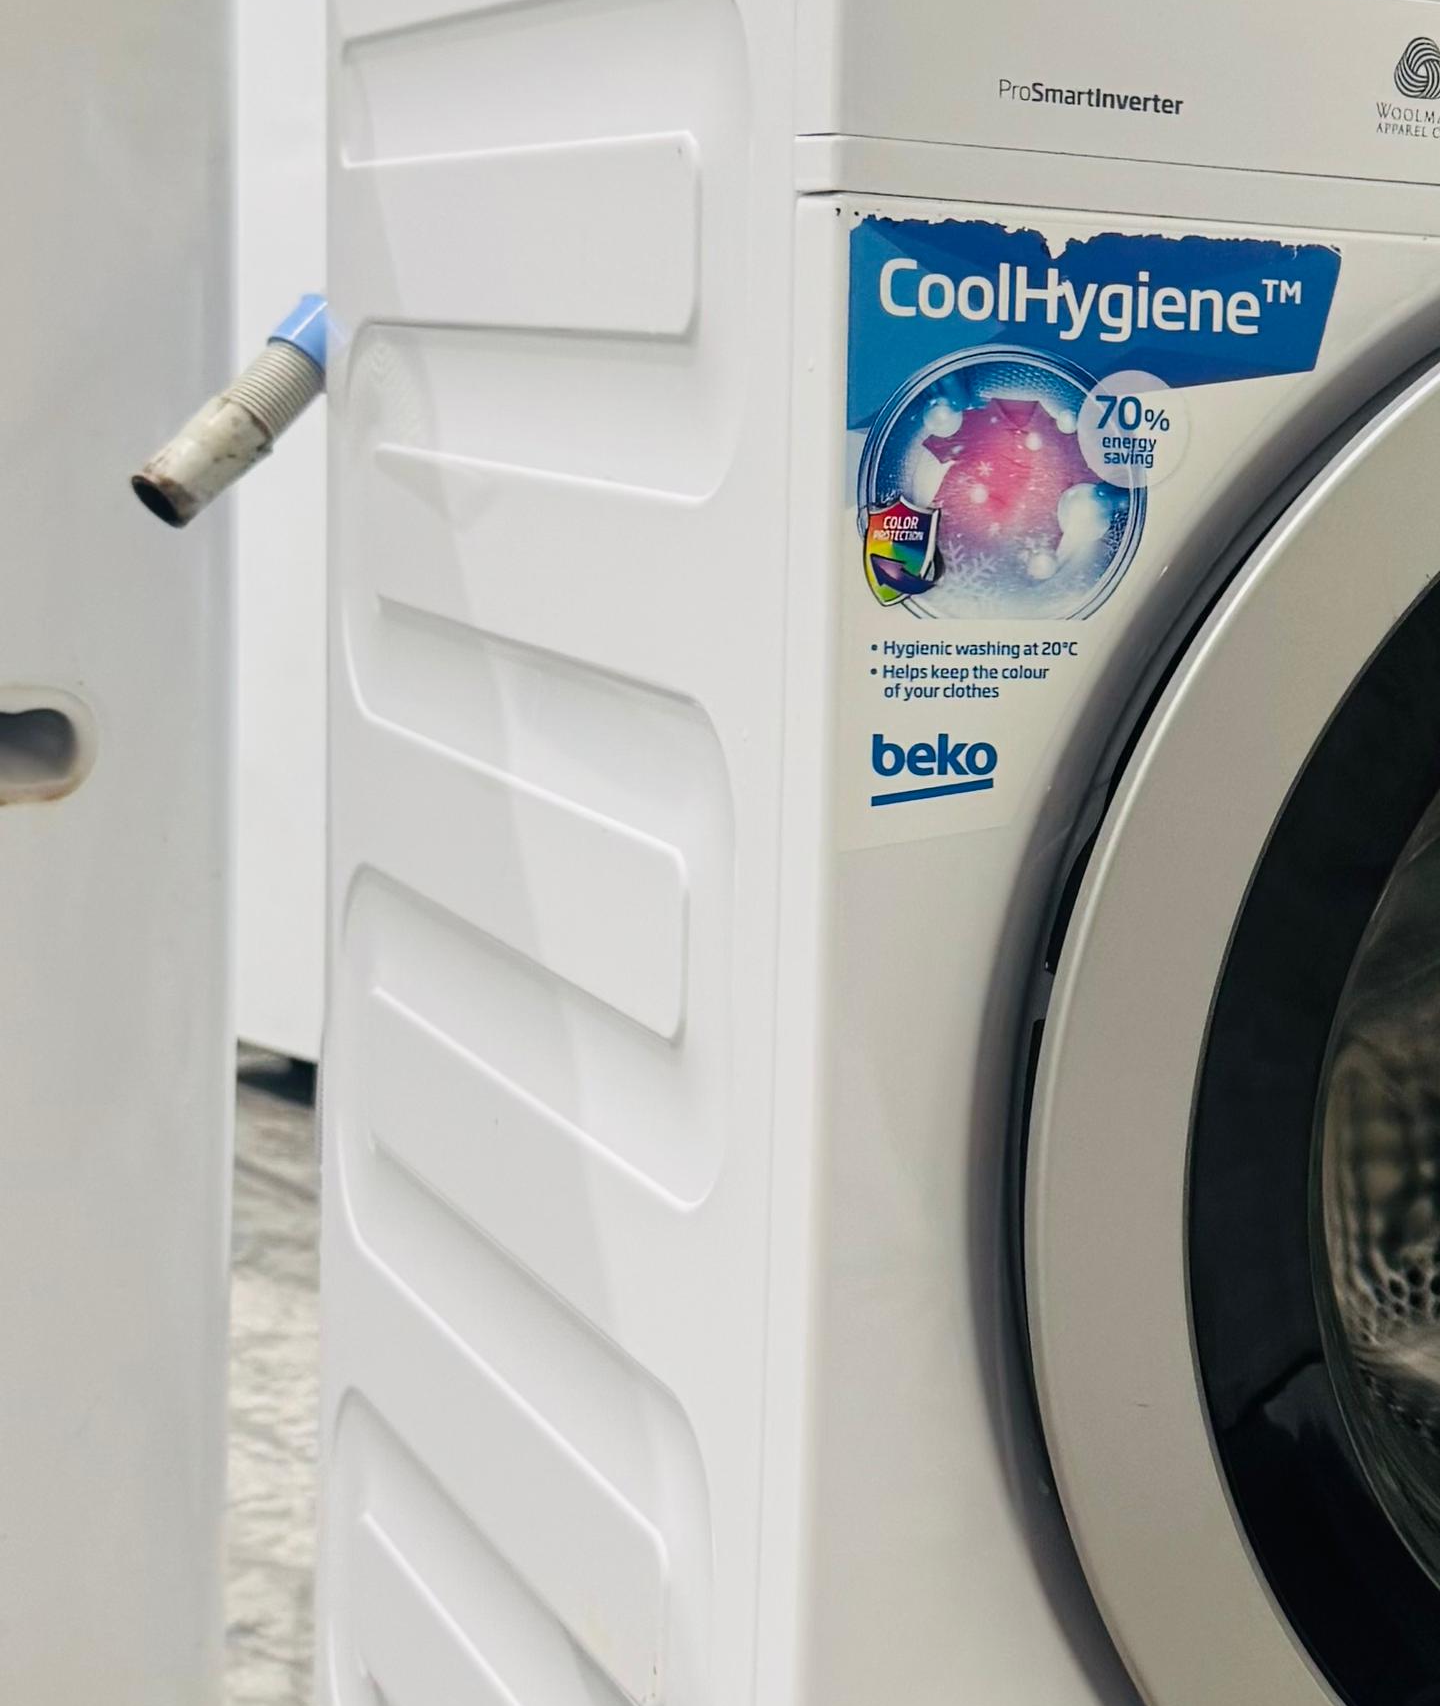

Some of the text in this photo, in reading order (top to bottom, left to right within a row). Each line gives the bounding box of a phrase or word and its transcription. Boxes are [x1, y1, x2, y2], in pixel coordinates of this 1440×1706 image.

[998, 79, 1183, 116] ProSmartInverter
[1376, 121, 1427, 139] APPAREL
[1095, 395, 1170, 433] 70%
[1101, 435, 1157, 453] energy
[1103, 450, 1154, 469] saving
[883, 516, 918, 531] COLOR
[873, 529, 924, 542] PROTECTION
[883, 641, 1078, 659] Hygienic washing at 20°C
[882, 665, 1049, 682] Helps keep the colour
[884, 683, 999, 701] of your clothes
[872, 733, 998, 776] beko
